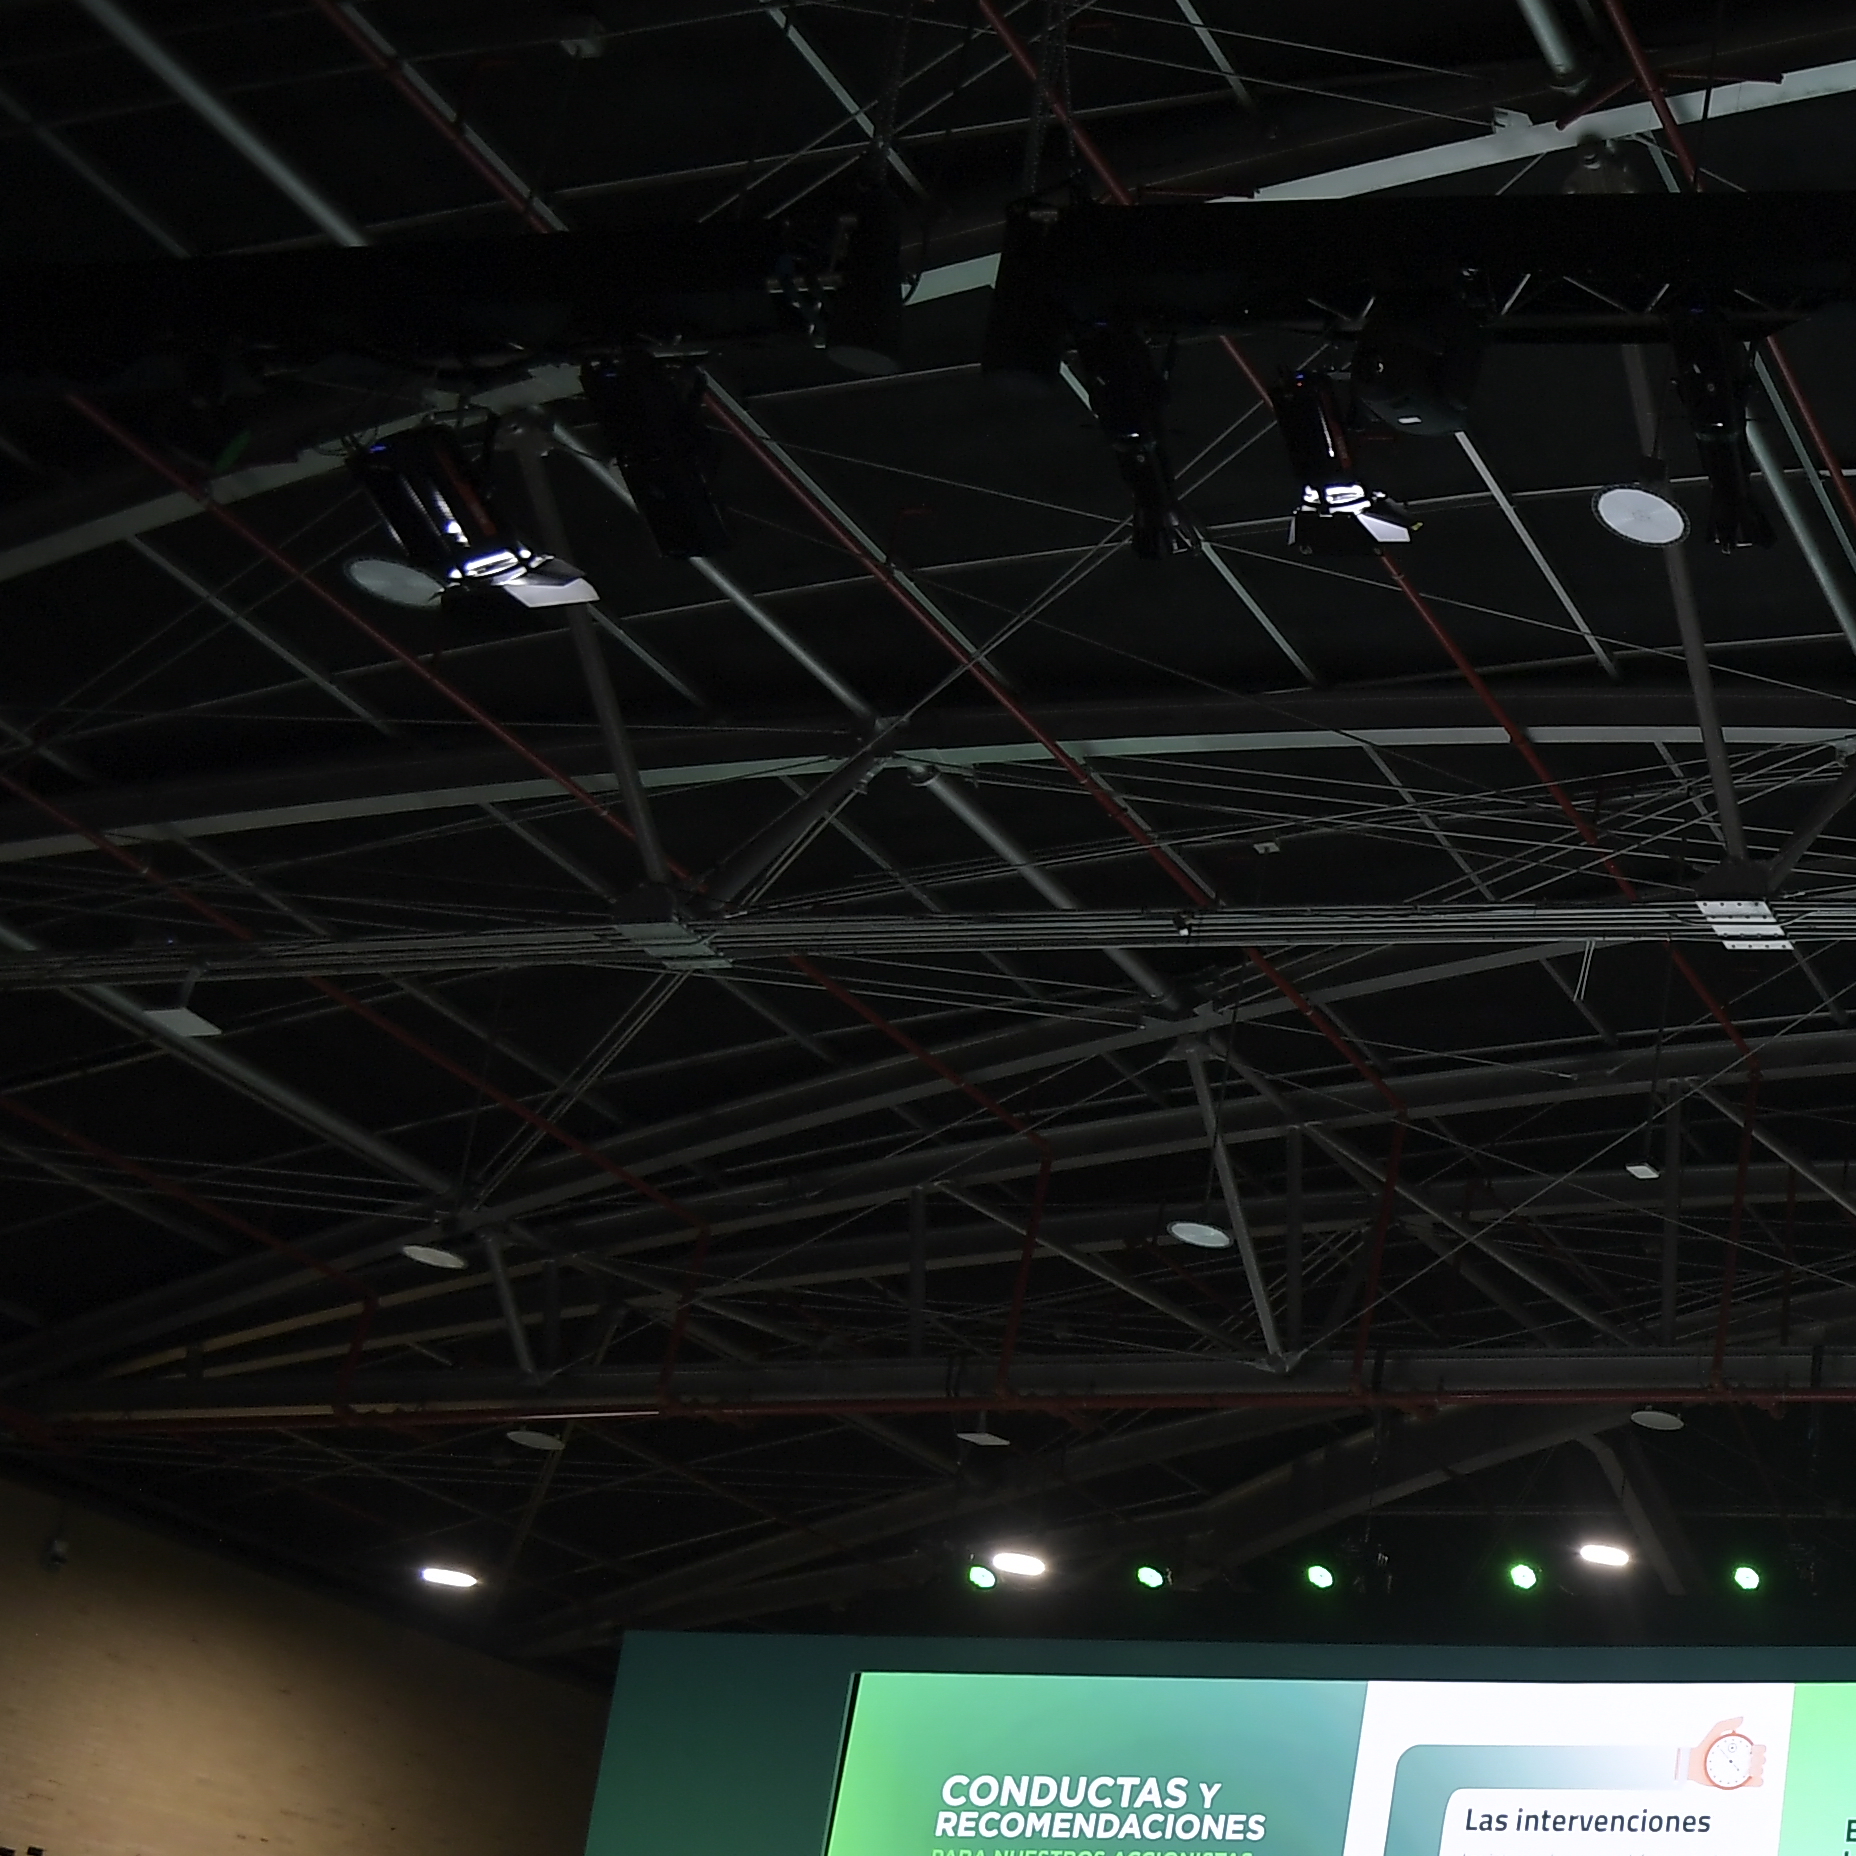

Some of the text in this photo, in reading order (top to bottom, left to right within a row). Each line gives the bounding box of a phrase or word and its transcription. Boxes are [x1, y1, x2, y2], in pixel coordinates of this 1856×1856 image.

[942, 1775, 1222, 1809] CONDUCTAS Y
[935, 1811, 1266, 1840] RECOMENDACIONES
[1466, 1808, 1711, 1832] Las intervenciones
